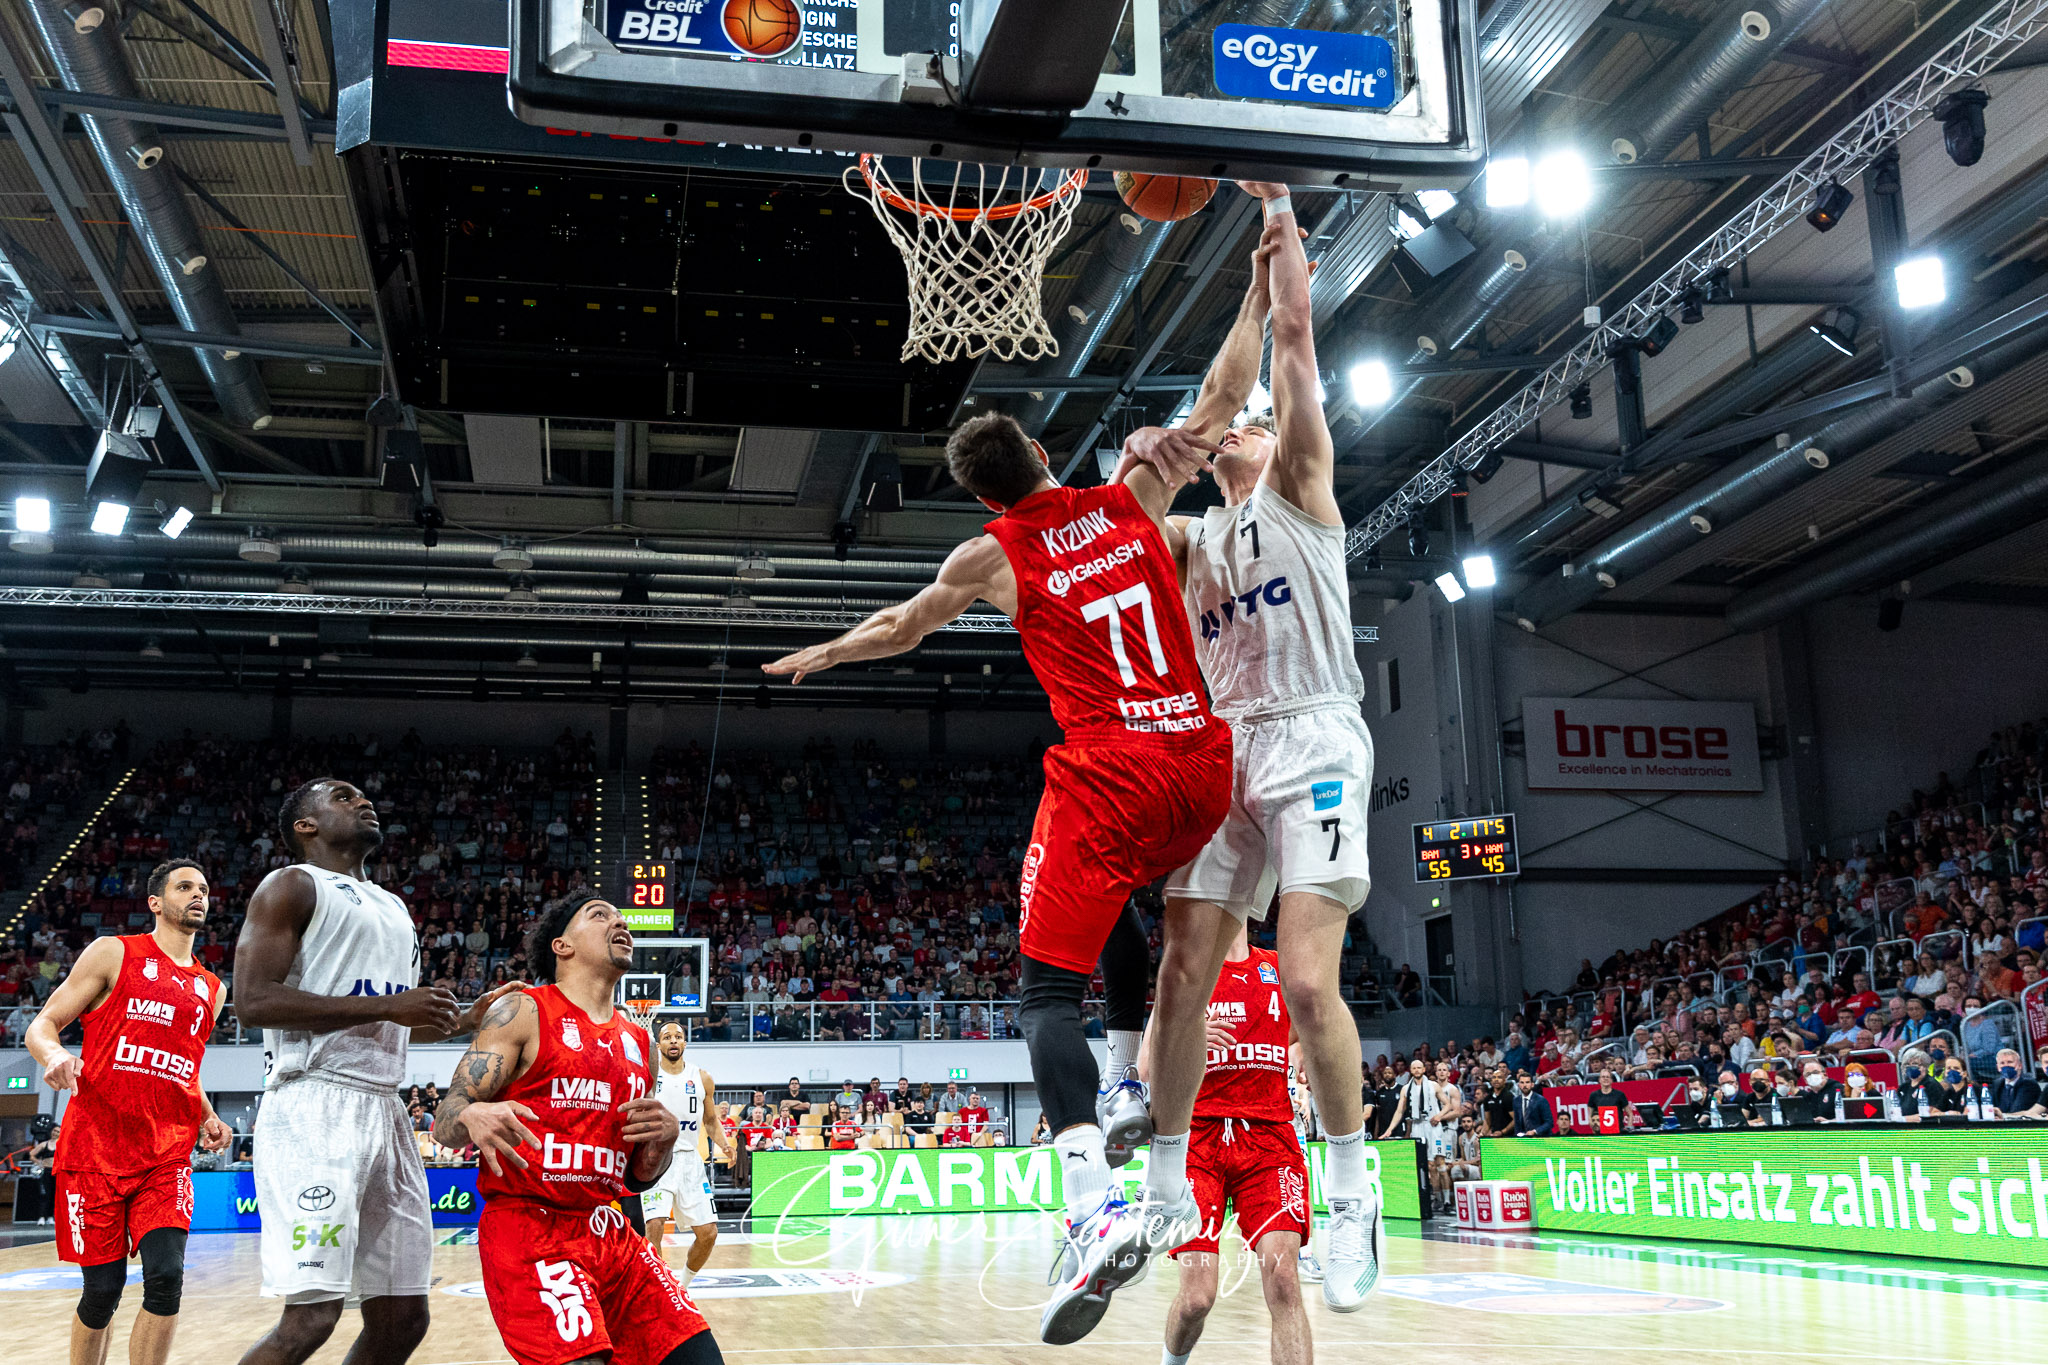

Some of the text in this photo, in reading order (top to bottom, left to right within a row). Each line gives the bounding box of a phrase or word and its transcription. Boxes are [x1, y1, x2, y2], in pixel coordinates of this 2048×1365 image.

[619, 12, 702, 45] BBL
[1241, 520, 1260, 560] 7
[1068, 539, 1145, 584] IGARASHI
[1080, 581, 1169, 688] 77
[1117, 691, 1199, 719] brose
[1554, 709, 1729, 759] brose
[1558, 763, 1732, 777] Excellence in Mechatronics
[1371, 776, 1409, 813] links
[1320, 818, 1340, 862] 7
[1422, 827, 1433, 840] 4
[1421, 843, 1504, 860] BAM 3 HAM
[633, 864, 666, 879] 2.17
[1428, 854, 1505, 879] 55 45
[633, 884, 665, 905] 20
[126, 998, 161, 1016] LVM
[1267, 990, 1281, 1022] 4
[126, 1013, 173, 1027] VERSICHERUNG
[190, 1005, 204, 1036] 3
[115, 1035, 195, 1079] brose
[551, 1078, 597, 1100] LVM
[550, 1100, 610, 1112] VERSICHERUNG
[1602, 1110, 1615, 1127] 5
[543, 1132, 628, 1179] bros
[542, 1172, 594, 1183] Excellence
[1502, 1191, 1527, 1202] RHÖN
[1545, 1156, 1639, 1215] Voller
[1647, 1156, 1797, 1222] Einsatz
[1805, 1156, 1937, 1231] zahlt
[292, 1224, 345, 1251] S+K
[638, 1250, 684, 1312] AUTOMATION
